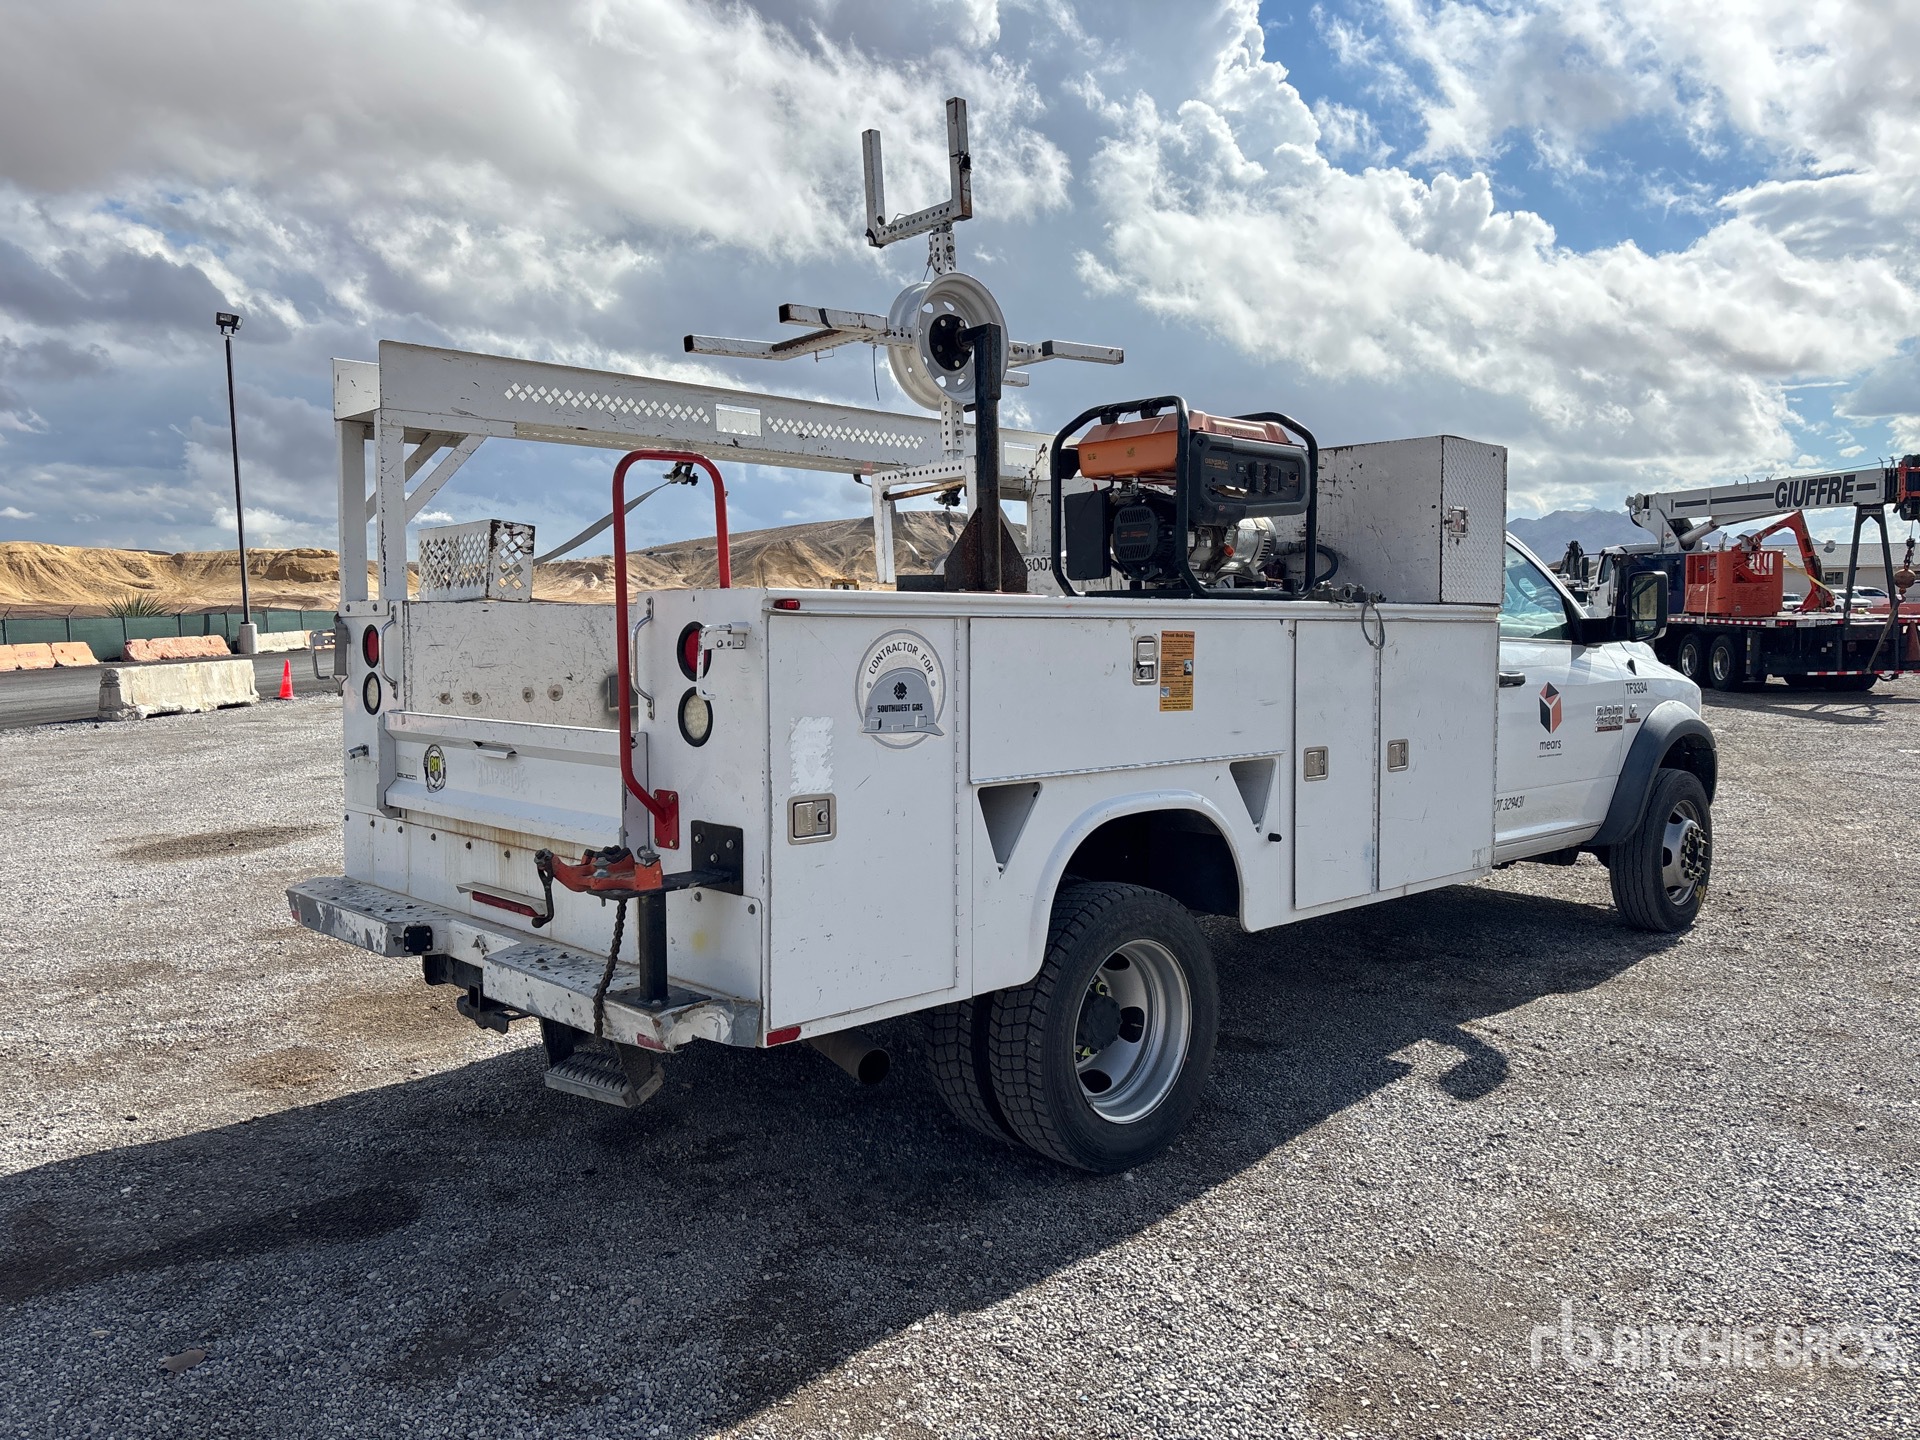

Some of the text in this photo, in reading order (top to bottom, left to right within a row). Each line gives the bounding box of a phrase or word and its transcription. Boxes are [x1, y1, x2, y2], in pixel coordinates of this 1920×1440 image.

[1775, 474, 1856, 508] GIUFFRE
[868, 642, 934, 675] CONTRACTOR FOR
[1625, 682, 1648, 695] TF3334
[877, 703, 923, 713] SOUTHWEST GAS
[1539, 740, 1562, 750] mears
[1503, 795, 1526, 811] 329431
